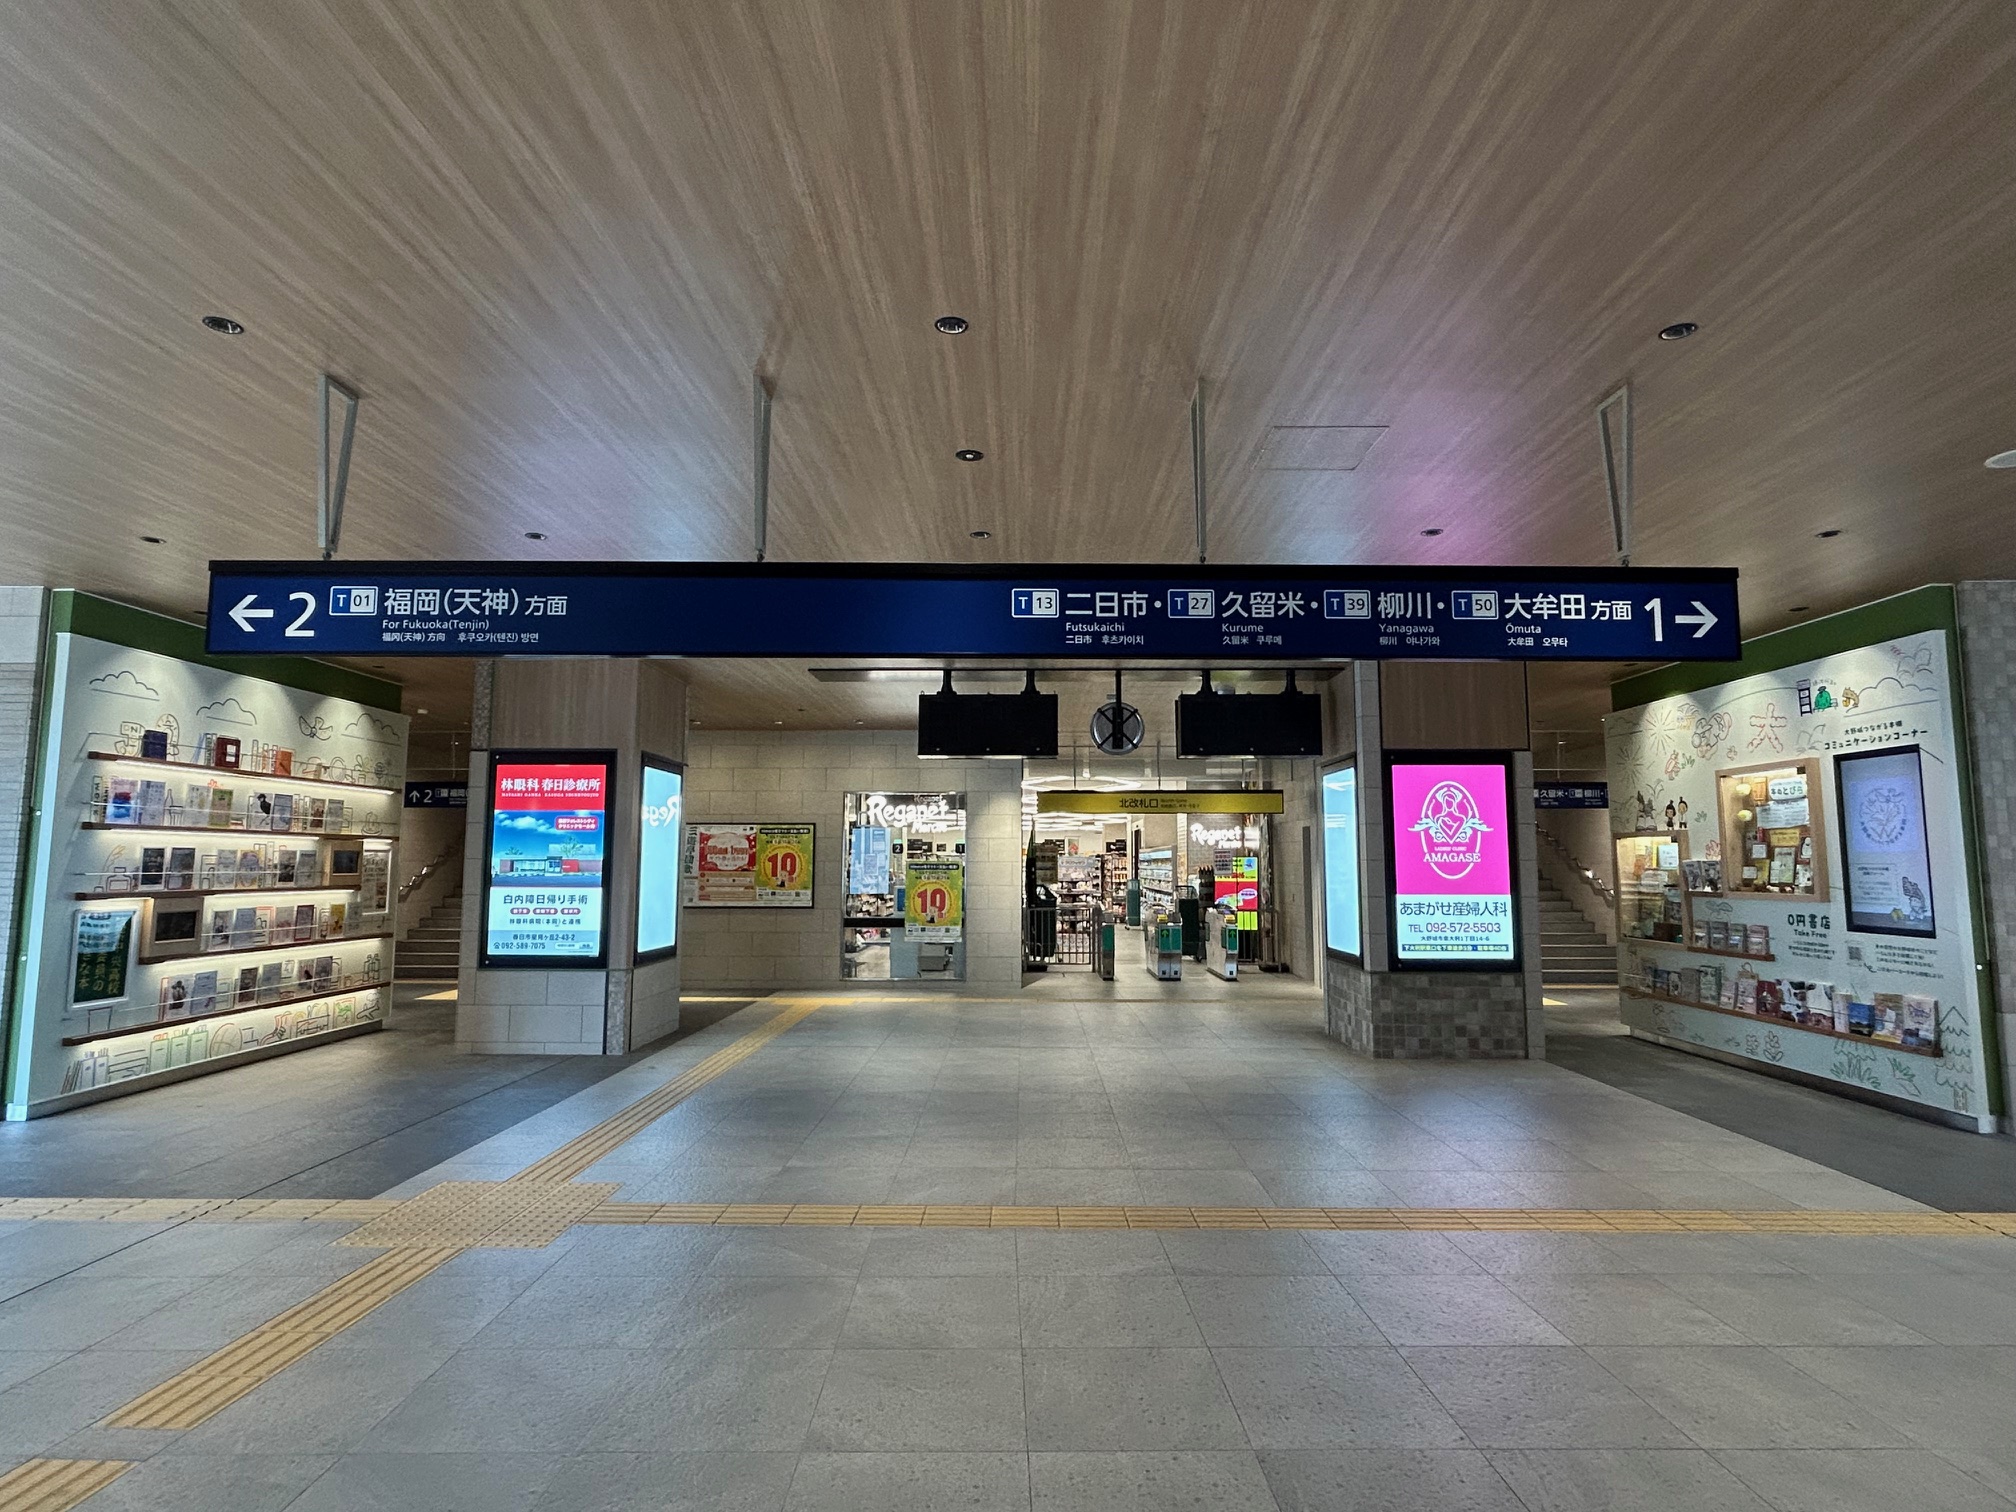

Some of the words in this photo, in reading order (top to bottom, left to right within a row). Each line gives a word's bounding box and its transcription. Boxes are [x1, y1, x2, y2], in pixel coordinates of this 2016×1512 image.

[336, 594, 346, 607] T
[353, 594, 372, 607] 01
[384, 588, 520, 616] 福岡(天神)
[525, 595, 568, 616] 方面
[1018, 596, 1028, 610] T
[1035, 596, 1053, 610] 13
[1174, 597, 1183, 610] T
[1190, 597, 1209, 610] 27
[1330, 598, 1340, 611] T
[1347, 598, 1365, 611] 39
[1458, 599, 1468, 611] T
[1474, 599, 1493, 612] 50
[1504, 593, 1586, 620] 大牟田
[1590, 600, 1632, 621] 方面
[284, 592, 317, 637] 2
[1644, 597, 1663, 642] 1
[382, 619, 400, 629] For
[402, 619, 489, 631] Fukuoka(Tenjin)
[1065, 622, 1125, 632] Futsukaichi
[1221, 623, 1264, 632] Kurume
[1378, 624, 1434, 636] Yanagawa
[426, 632, 446, 642] 方向
[1065, 635, 1092, 645] 二日市
[1222, 635, 1249, 645] 久留米
[1379, 636, 1397, 646] 柳川
[1507, 637, 1534, 647] 大牟田
[1824, 728, 1928, 750] コミュニケーションコーナー
[501, 778, 540, 791] 林眼科
[542, 778, 601, 791] 春日診療所
[423, 789, 432, 803] 2
[1119, 798, 1158, 809] 北改札口
[1423, 852, 1482, 863] AMAGASE
[503, 894, 588, 905] 白内障日帰り手術
[1399, 901, 1508, 917] あまがせ産婦人科
[1408, 924, 1424, 933] TEL
[1425, 922, 1502, 933] 092-572-5503
[1788, 913, 1831, 930] 0円書店
[1794, 929, 1810, 938] Take
[1811, 930, 1827, 939] Free
